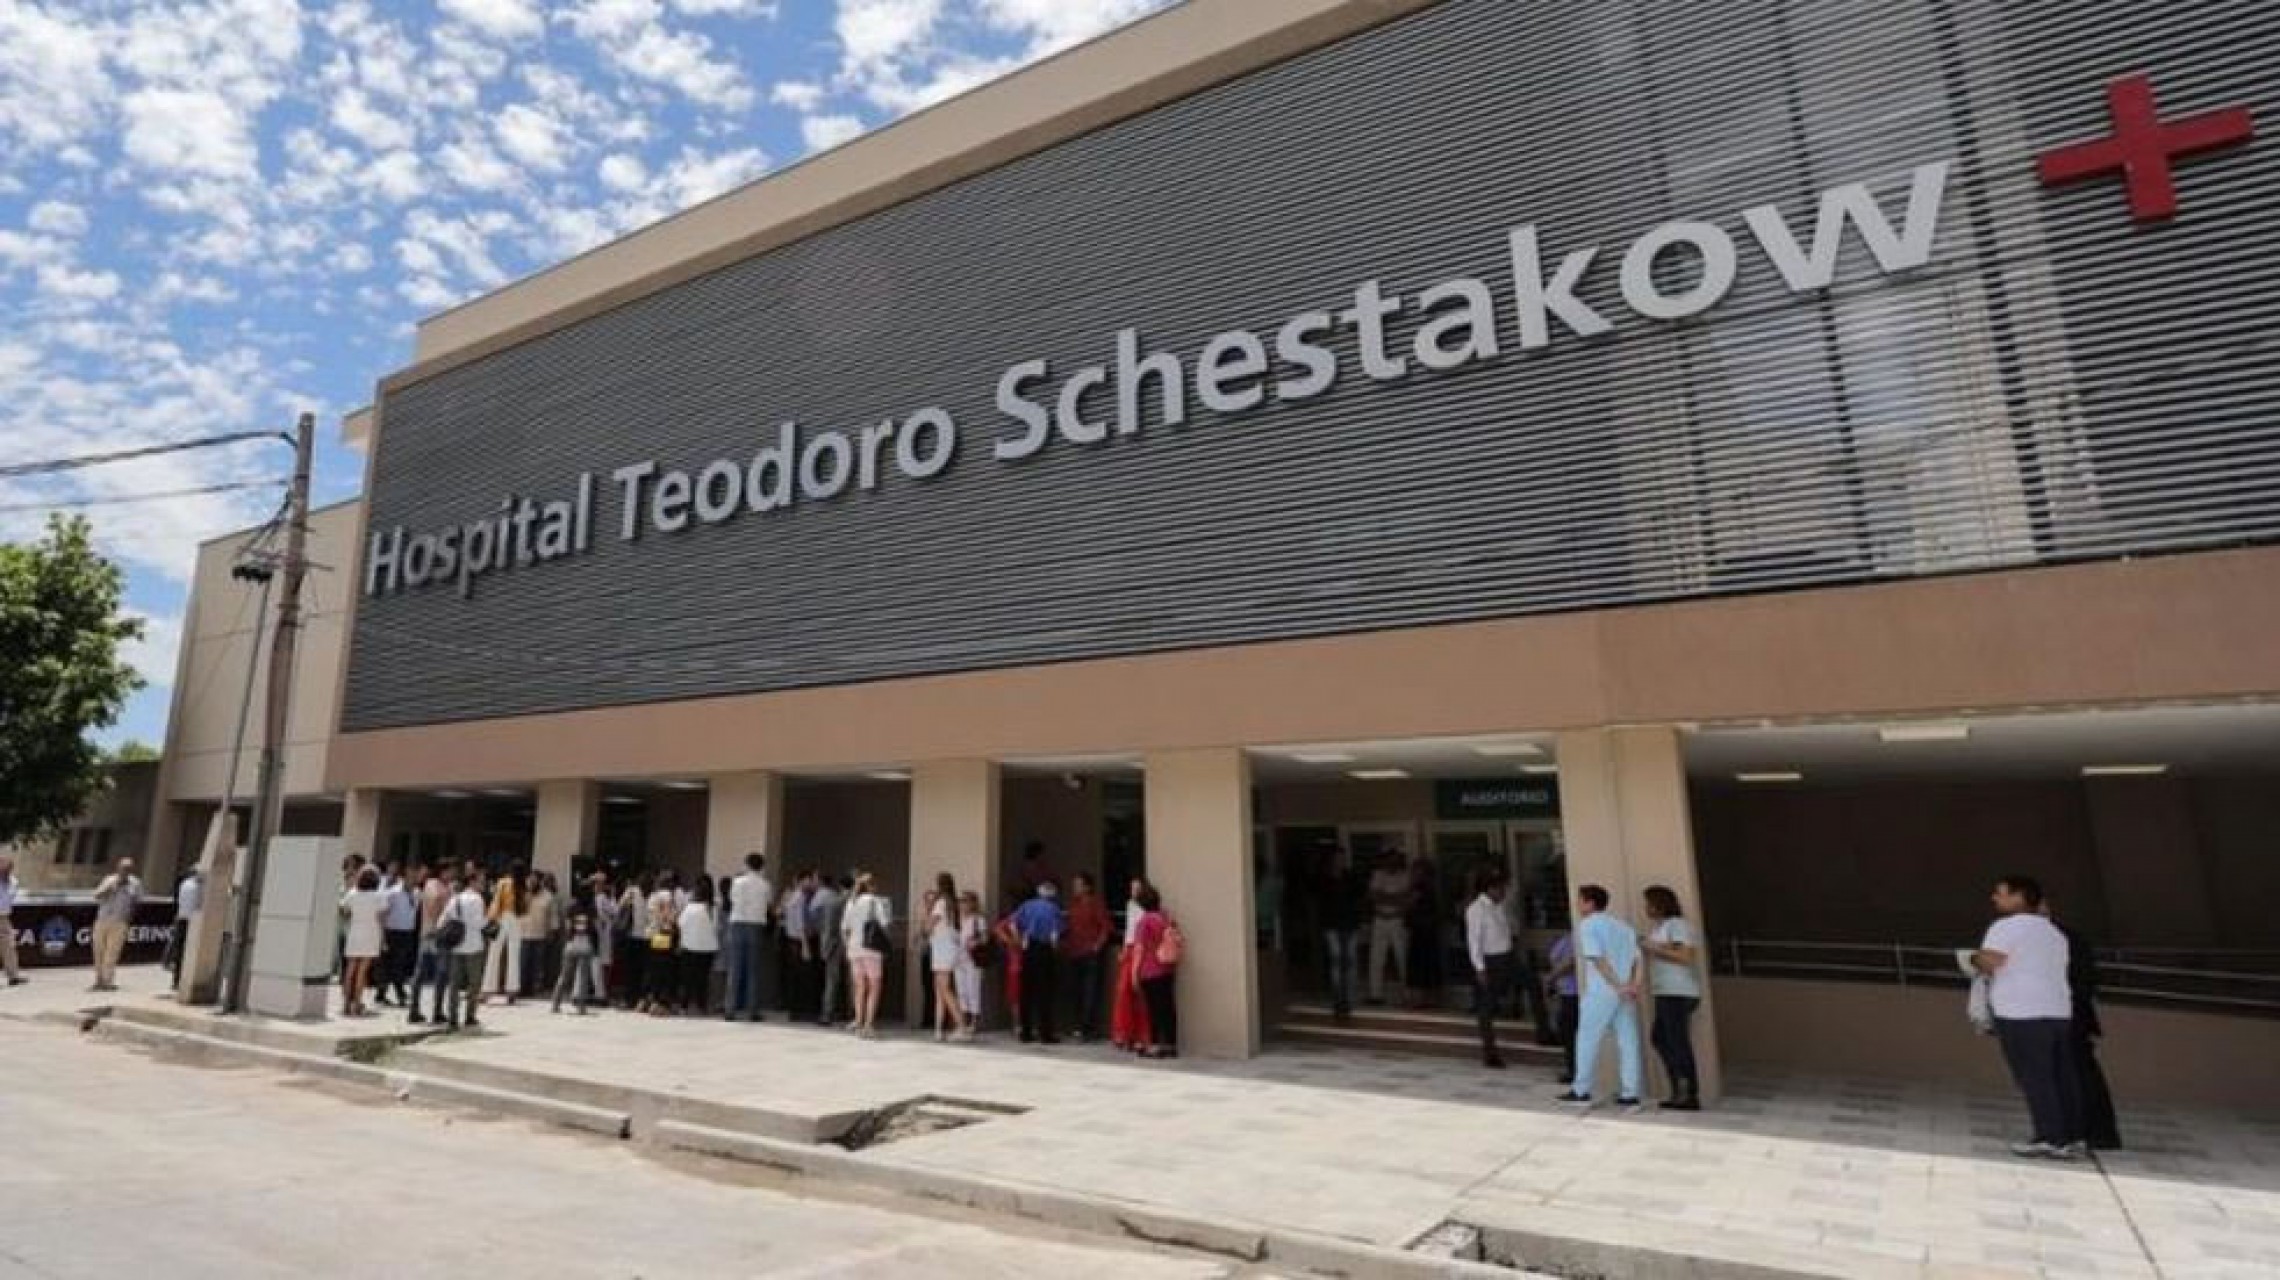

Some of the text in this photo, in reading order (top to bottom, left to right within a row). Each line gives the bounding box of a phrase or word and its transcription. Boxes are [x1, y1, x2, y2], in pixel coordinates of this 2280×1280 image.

[365, 160, 1950, 598] Hospital Teodoro Schestakow
